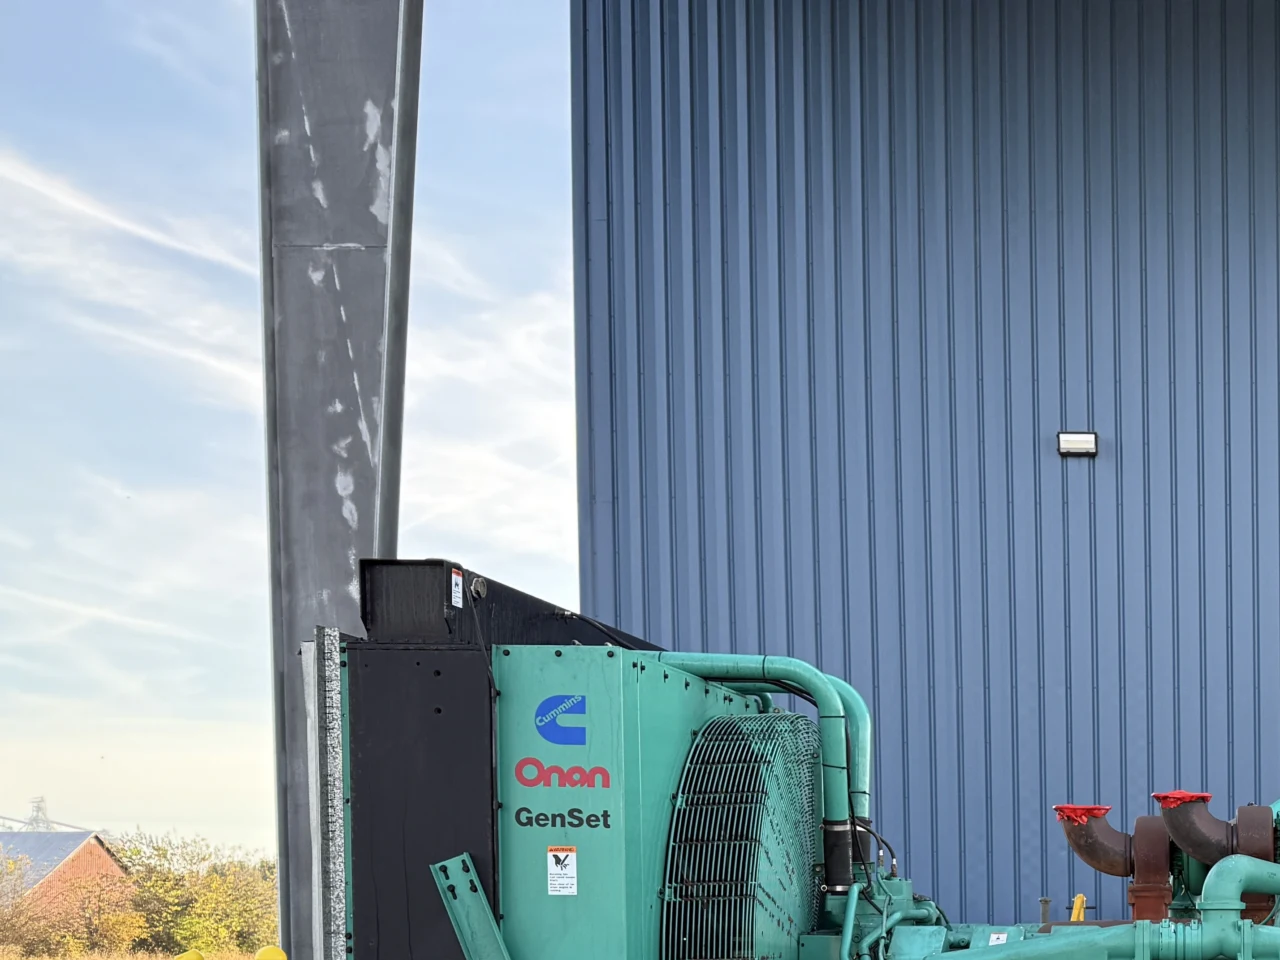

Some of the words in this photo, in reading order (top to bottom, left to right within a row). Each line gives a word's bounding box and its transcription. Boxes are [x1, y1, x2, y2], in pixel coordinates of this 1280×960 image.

[535, 695, 582, 726] Cummins
[515, 757, 610, 788] Onan
[515, 807, 611, 829] GenSet
